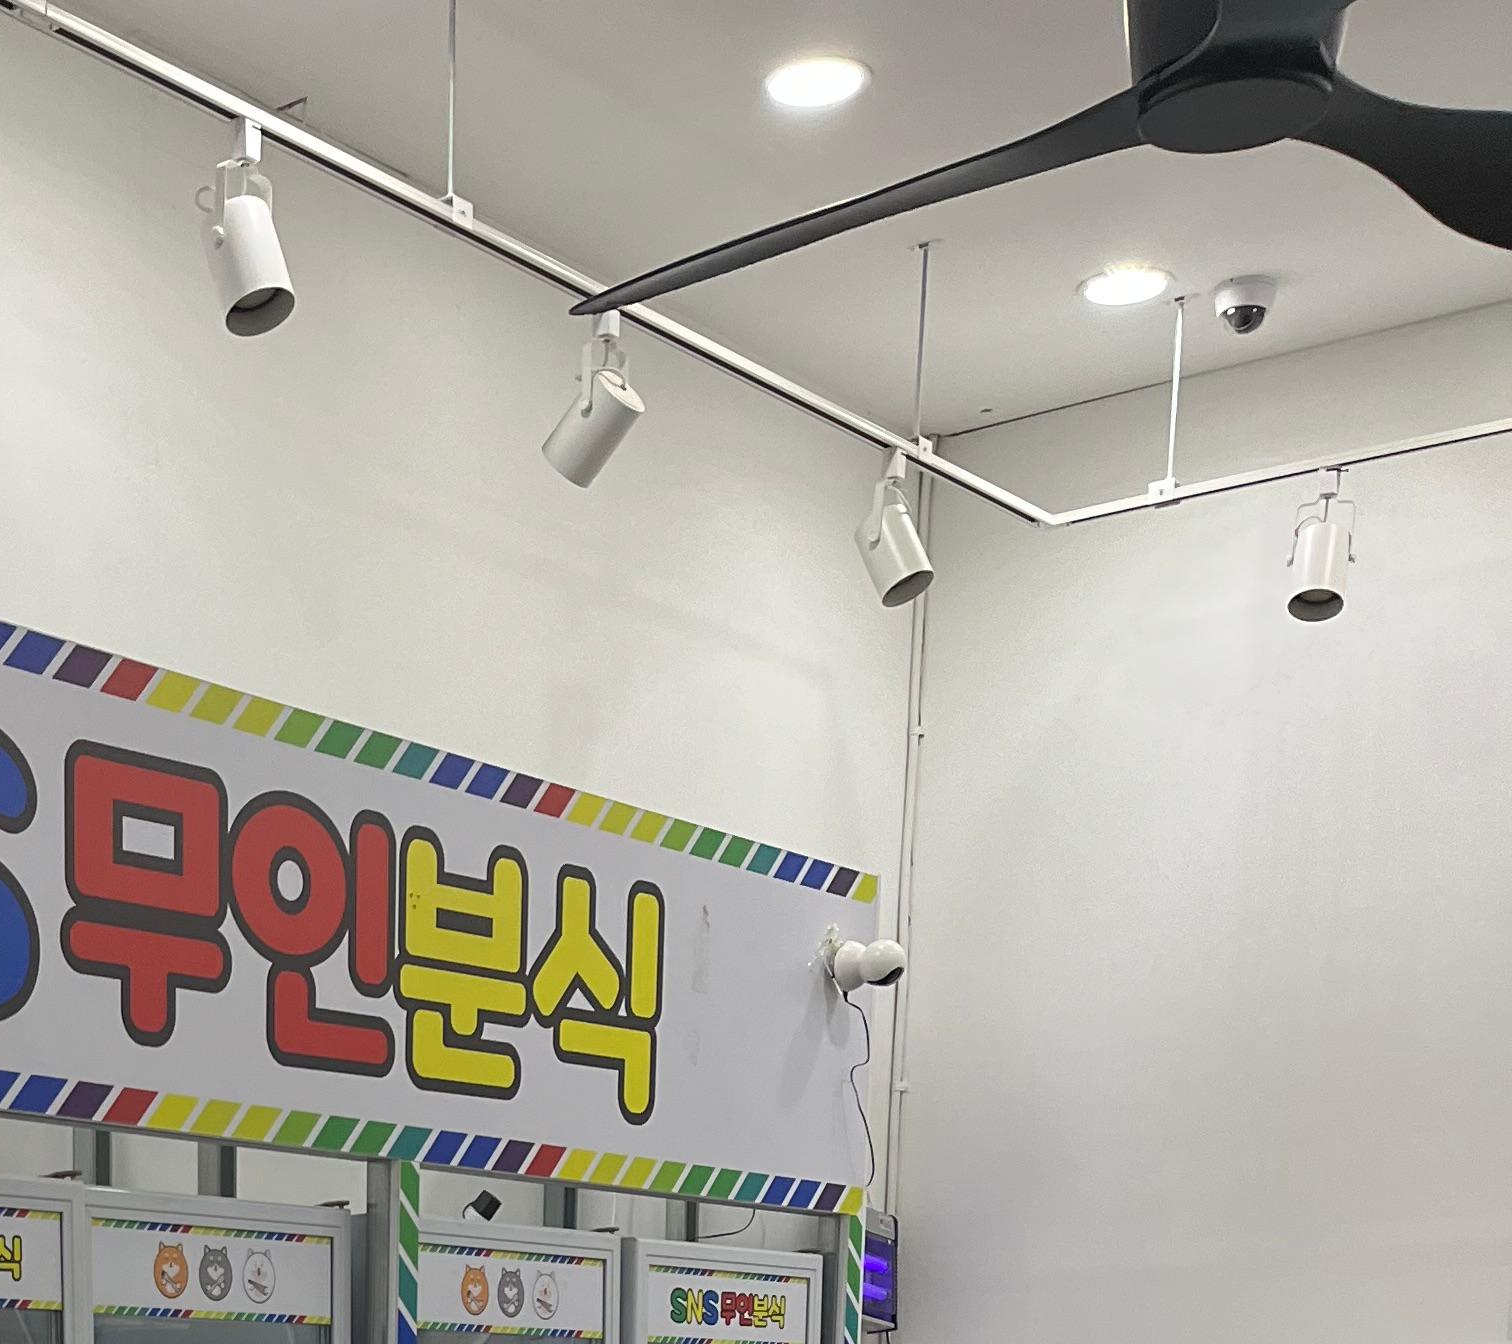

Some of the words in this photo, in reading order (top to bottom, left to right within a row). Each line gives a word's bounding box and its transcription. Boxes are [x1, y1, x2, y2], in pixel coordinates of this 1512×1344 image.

[60, 738, 665, 1125] 무인분식
[670, 1287, 719, 1326] SNS
[720, 1291, 787, 1329] 무인분식
